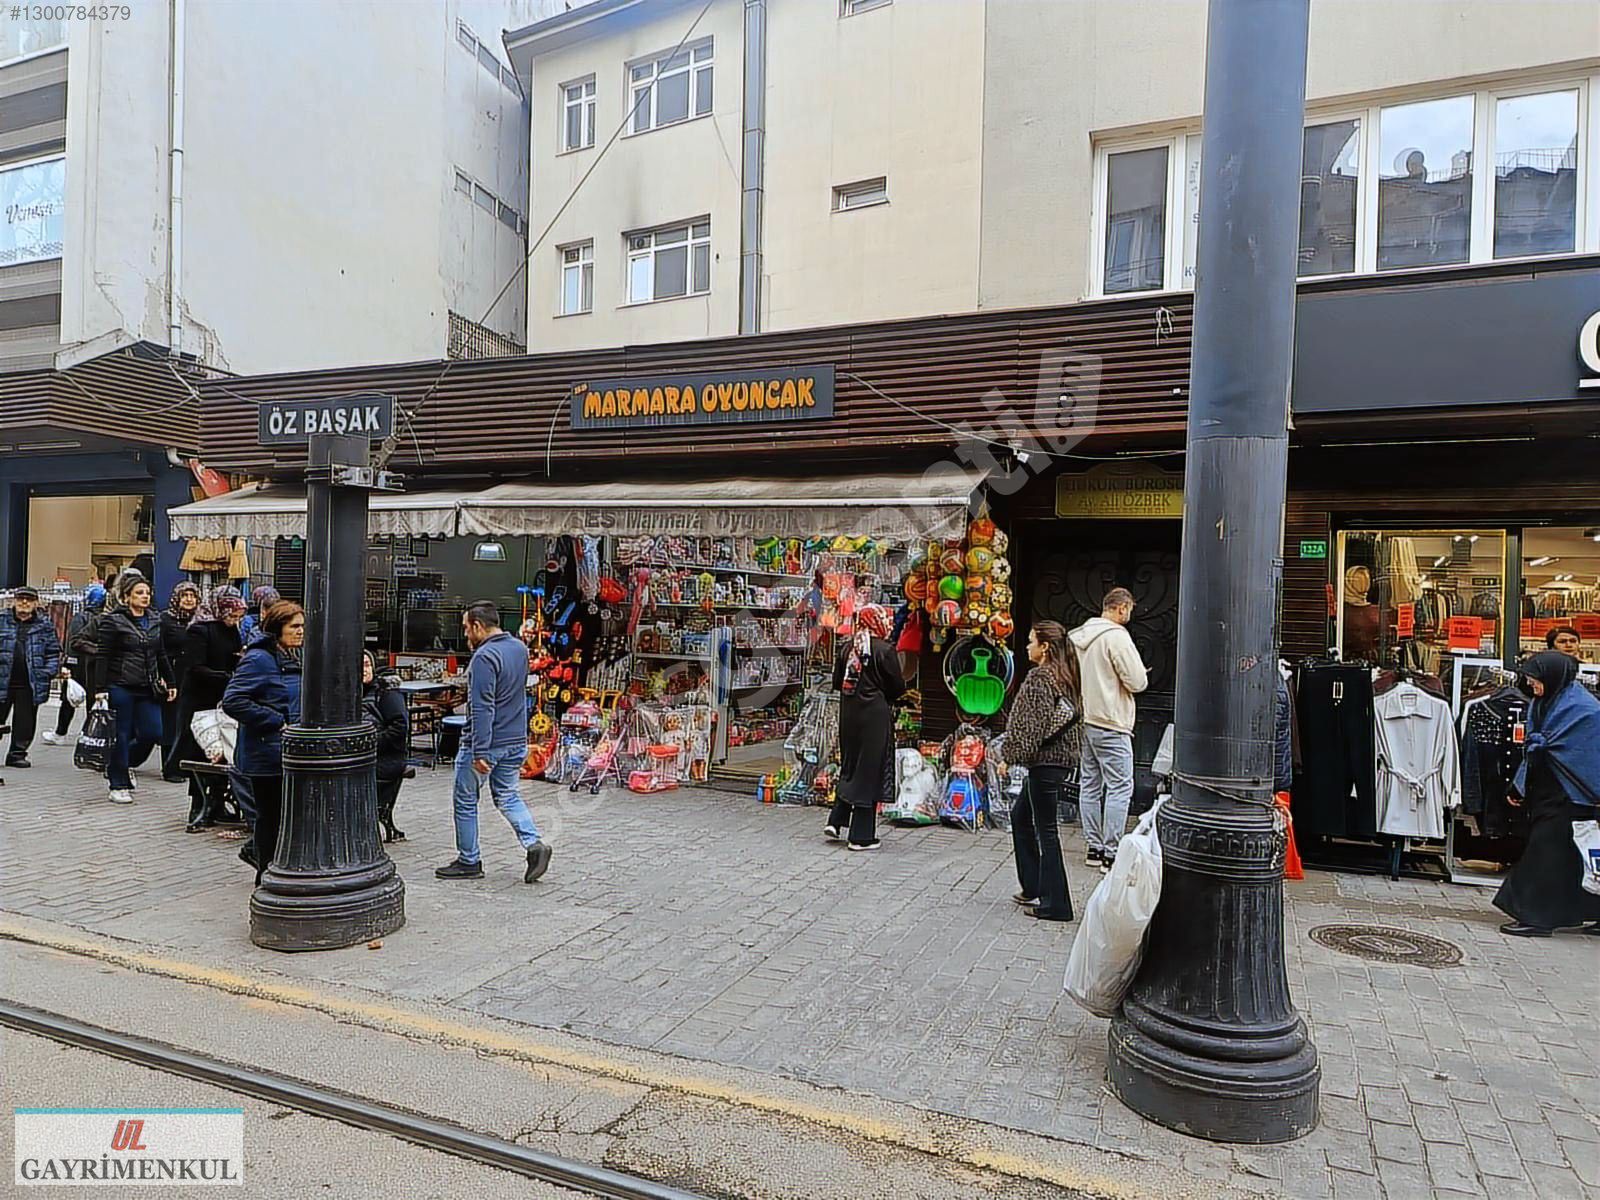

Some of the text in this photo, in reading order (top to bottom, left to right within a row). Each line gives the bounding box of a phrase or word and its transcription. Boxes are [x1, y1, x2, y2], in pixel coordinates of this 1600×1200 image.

[584, 377, 815, 418] MARMARA OYUNCAK
[269, 406, 380, 435] ÖZ BAŞAK
[1123, 490, 1171, 507] ÖZBEK
[584, 510, 616, 529] ES
[625, 510, 703, 530] Marmara
